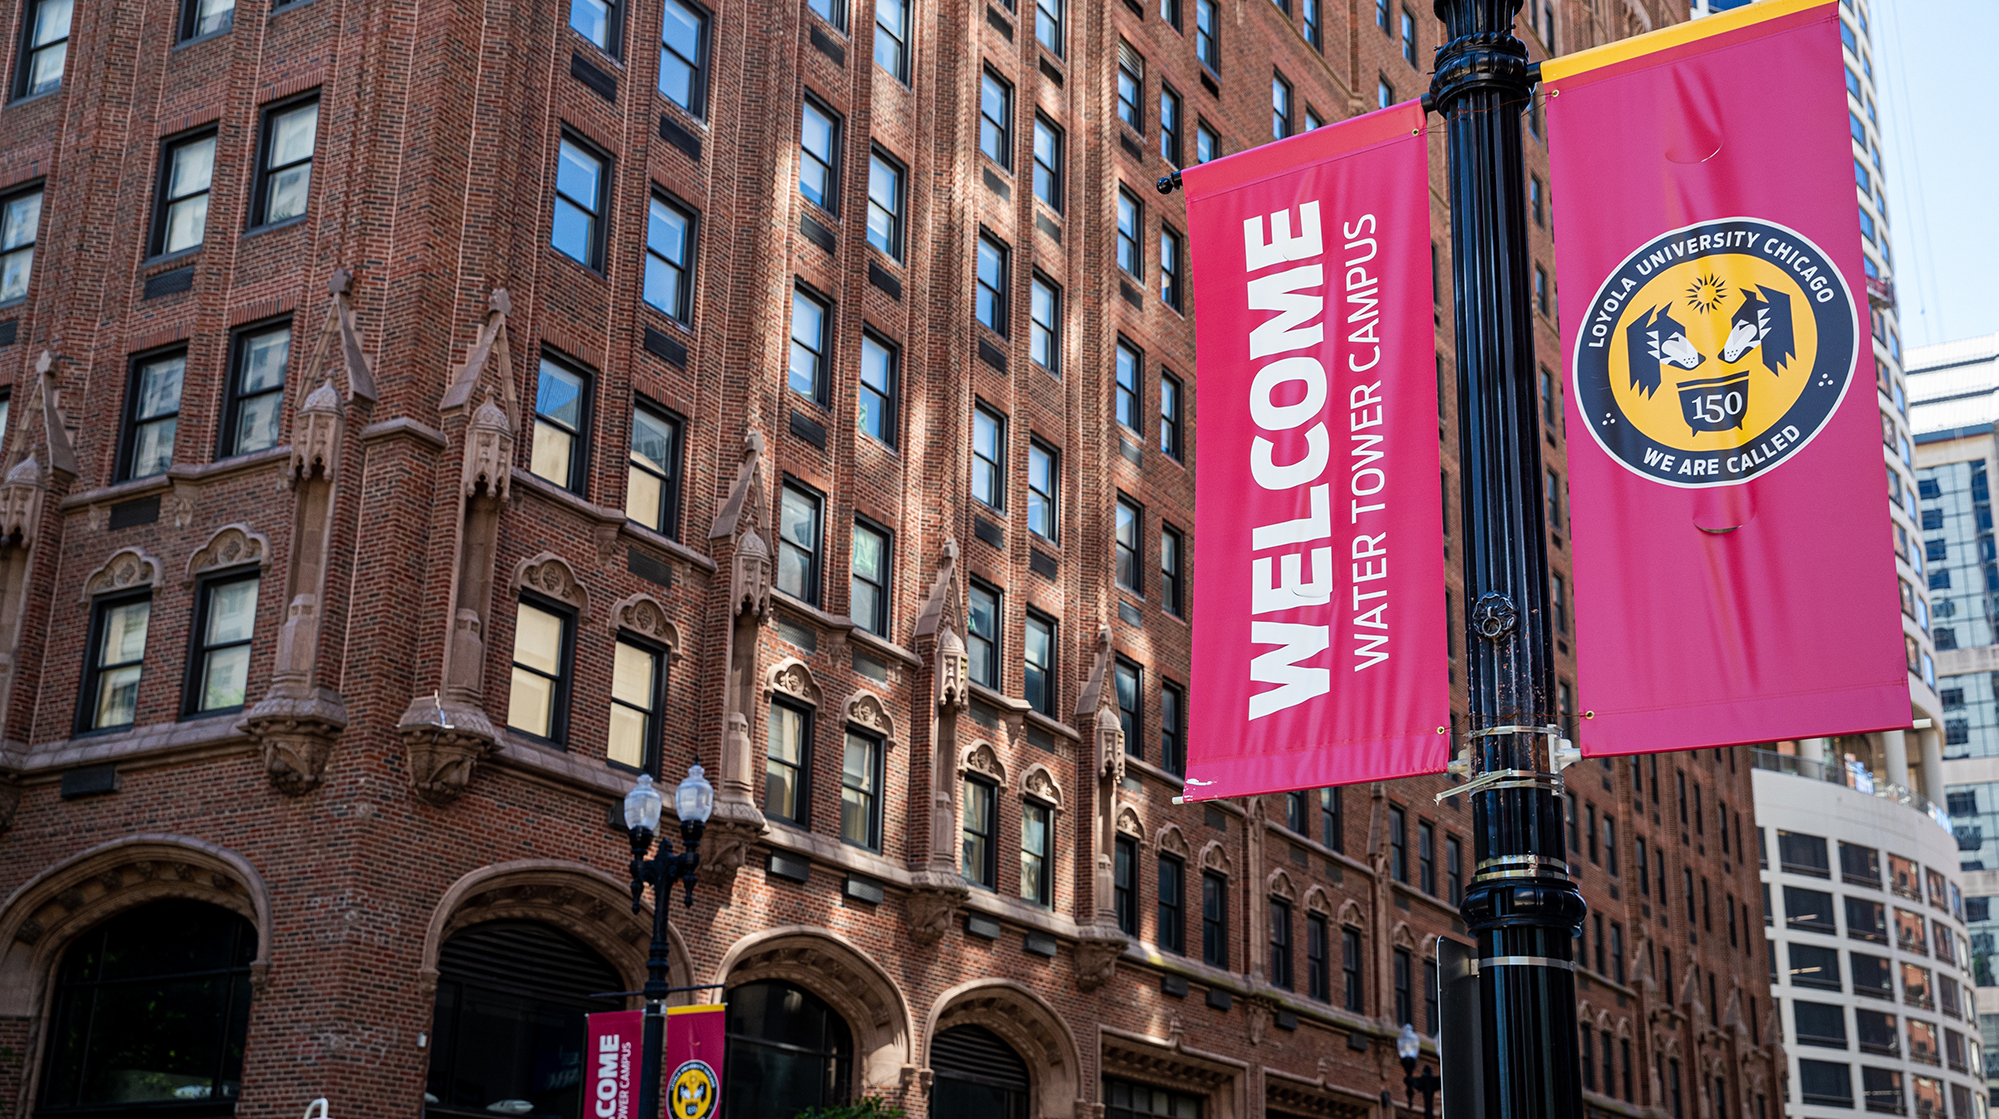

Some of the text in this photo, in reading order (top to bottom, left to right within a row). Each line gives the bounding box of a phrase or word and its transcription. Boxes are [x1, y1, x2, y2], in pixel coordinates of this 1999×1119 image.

[1588, 230, 1835, 349] LOYOLA UNIVERSITY CHICAGO
[1343, 213, 1390, 673] WATER TOWER CAMPUS
[1691, 390, 1743, 424] 150
[1243, 199, 1334, 722] WELCOME
[1642, 424, 1801, 476] WE ARE CALLED
[595, 1034, 620, 1119] COME
[619, 1041, 632, 1089] CAMPUS
